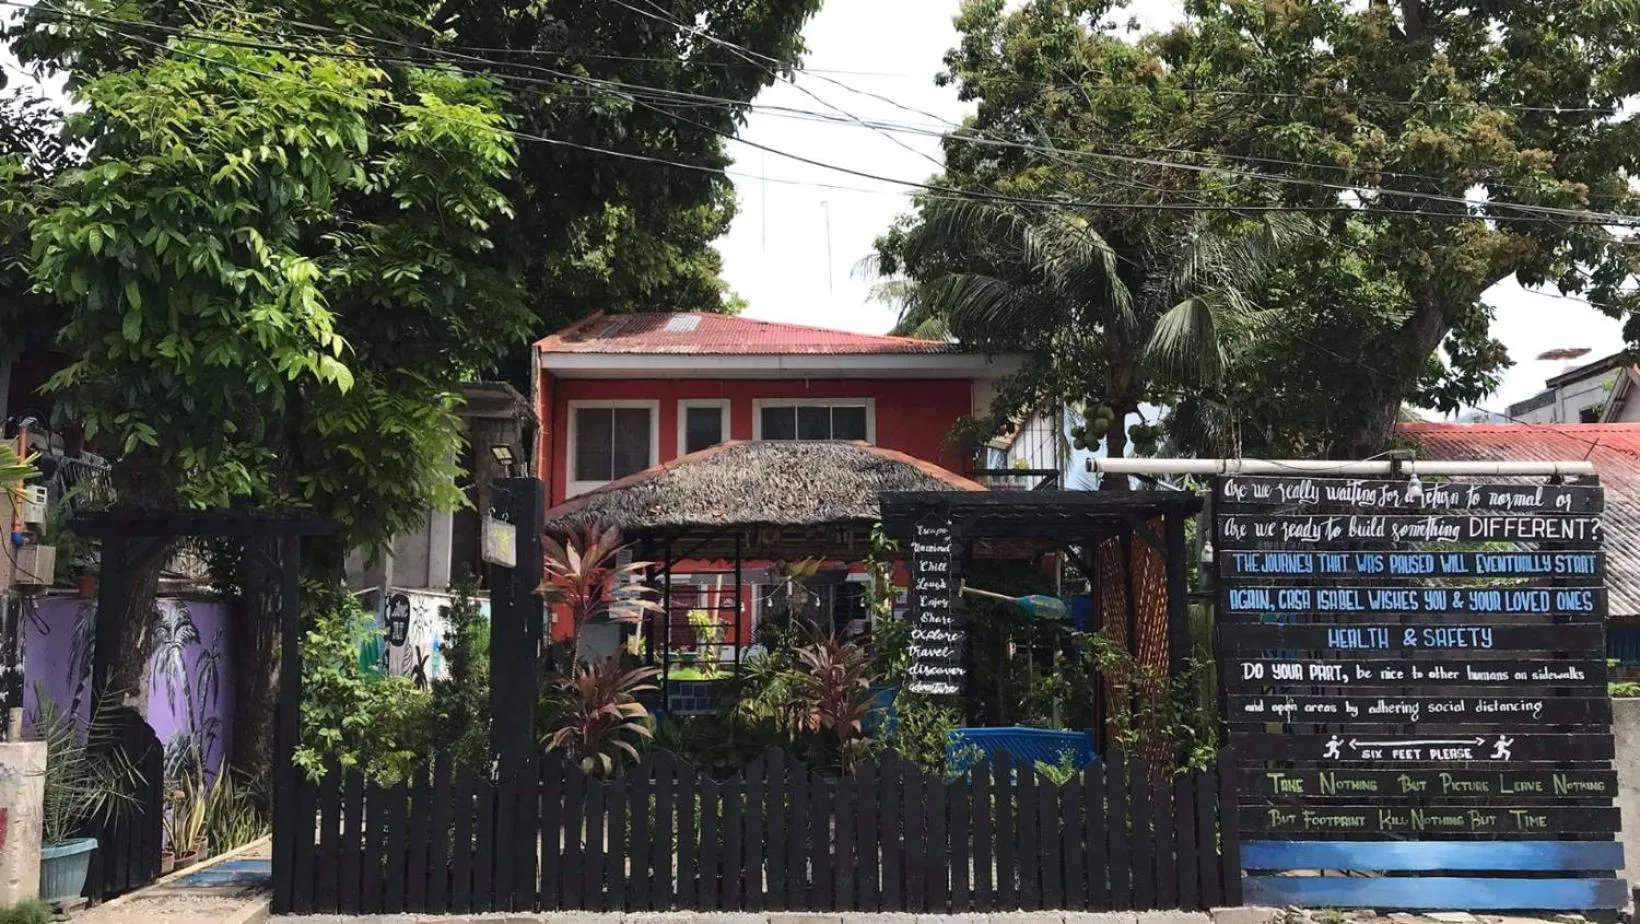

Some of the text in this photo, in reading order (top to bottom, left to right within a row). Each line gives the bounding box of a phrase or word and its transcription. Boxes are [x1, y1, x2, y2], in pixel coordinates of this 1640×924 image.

[1224, 479, 1247, 501] Are
[1252, 484, 1273, 498] we
[1275, 480, 1319, 504] really
[1326, 480, 1376, 506] waiting
[1378, 485, 1401, 507] for
[1404, 492, 1416, 503] a
[1466, 485, 1482, 509] to
[1489, 487, 1544, 510] normal
[1556, 494, 1572, 511] or
[1224, 516, 1601, 542] Are we ready to build something DIFFERENT?
[920, 560, 947, 572] Chill
[1232, 553, 1597, 574] THE JOURNEY THAT WAS PAUSED WILL EVENTUALLY START
[916, 577, 947, 590] Laugh
[1229, 589, 1593, 612] AGAIN, CASA ISABEL WISHES YOU & YOUR LOVED ONES
[920, 612, 955, 625] Share
[1328, 627, 1493, 648] HEALTH & SAFETY
[1241, 663, 1585, 684] DO YOUR PART, be nice to other humans on sidewalks
[1244, 699, 1543, 722] and open areas by adhering social distancing
[1361, 748, 1473, 760] SIX FEET PLEASE
